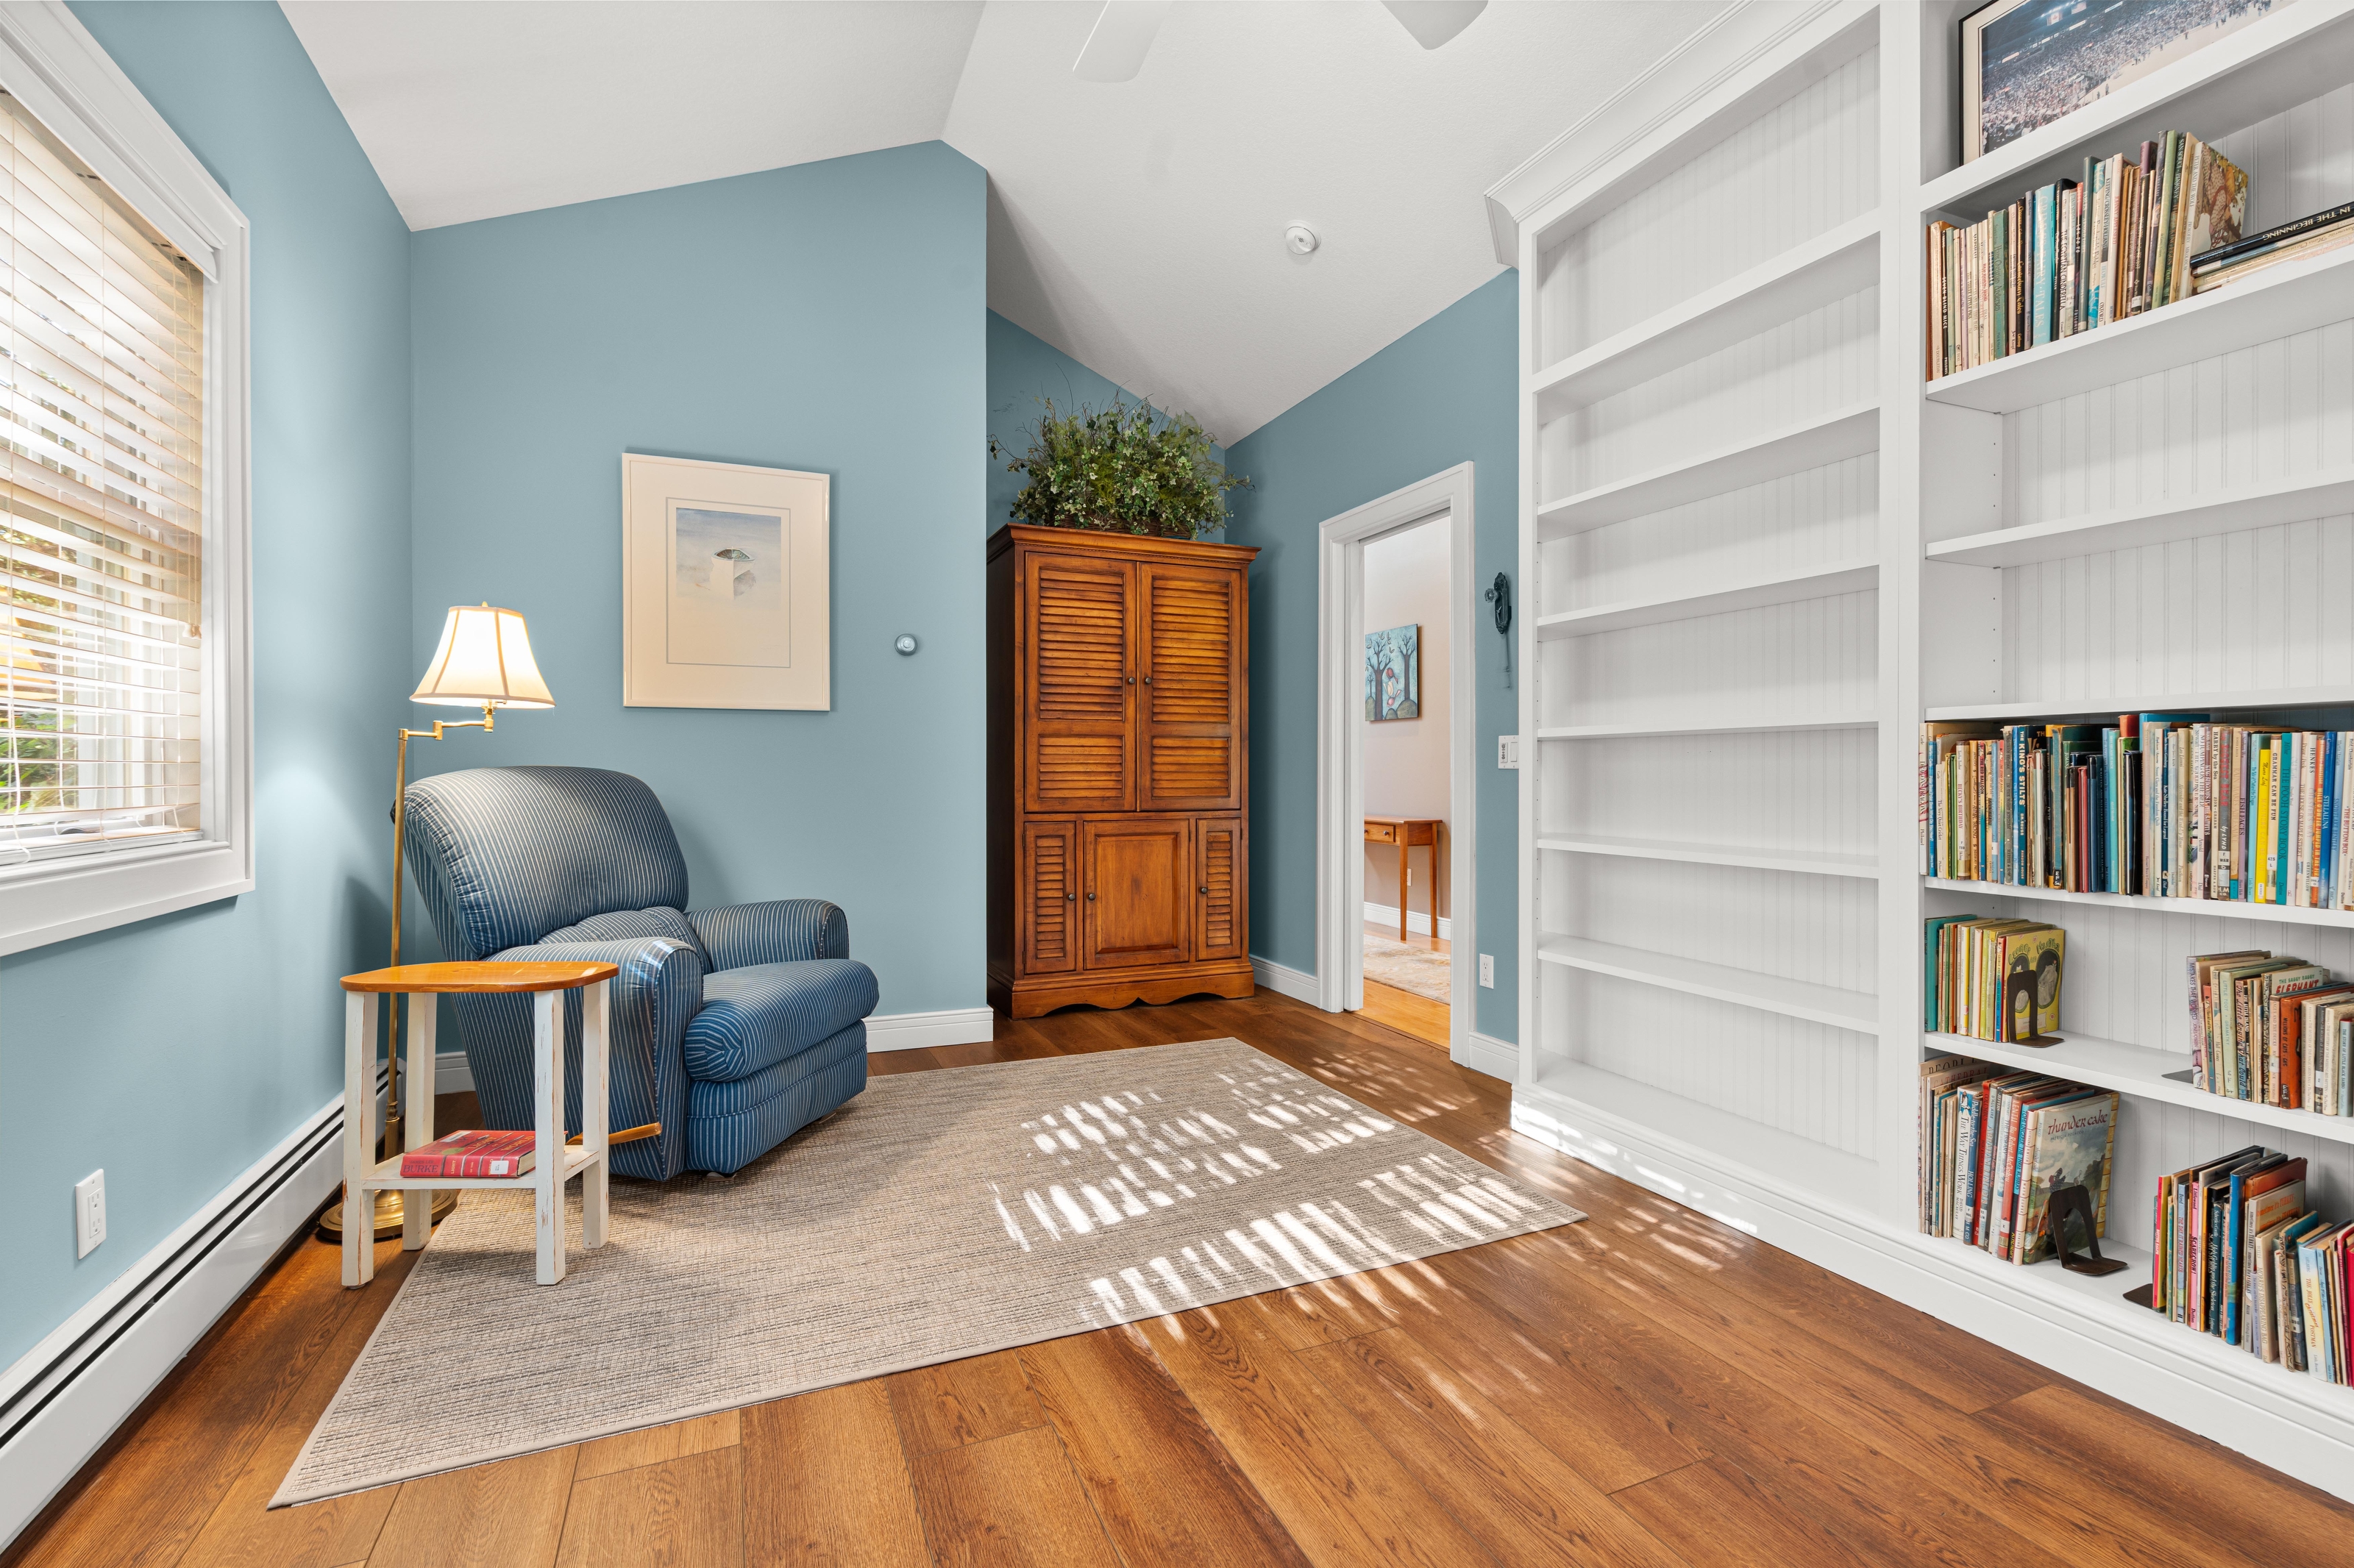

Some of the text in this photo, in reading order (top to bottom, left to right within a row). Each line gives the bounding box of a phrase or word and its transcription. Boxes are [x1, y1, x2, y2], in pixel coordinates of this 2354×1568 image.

[2262, 207, 2350, 241] IN THE BEGINNING
[2035, 291, 2046, 327] TALES
[2220, 744, 2230, 779] BIGGEST
[2200, 771, 2205, 780] ON
[2282, 769, 2290, 784] THE
[2220, 783, 2230, 807] BEAR
[2281, 785, 2289, 808] POOH
[2280, 810, 2289, 835] STORY
[2278, 838, 2286, 860] BOOK
[2189, 999, 2197, 1020] WORKED
[2236, 999, 2244, 1019] Little
[2087, 1109, 2108, 1126] cake
[1956, 1116, 1969, 1195] THE WAY THINGS WORK
[2008, 1136, 2017, 1153] Robert
[402, 1165, 438, 1174] BURKE
[2258, 1293, 2267, 1330] DISAPPEARING
